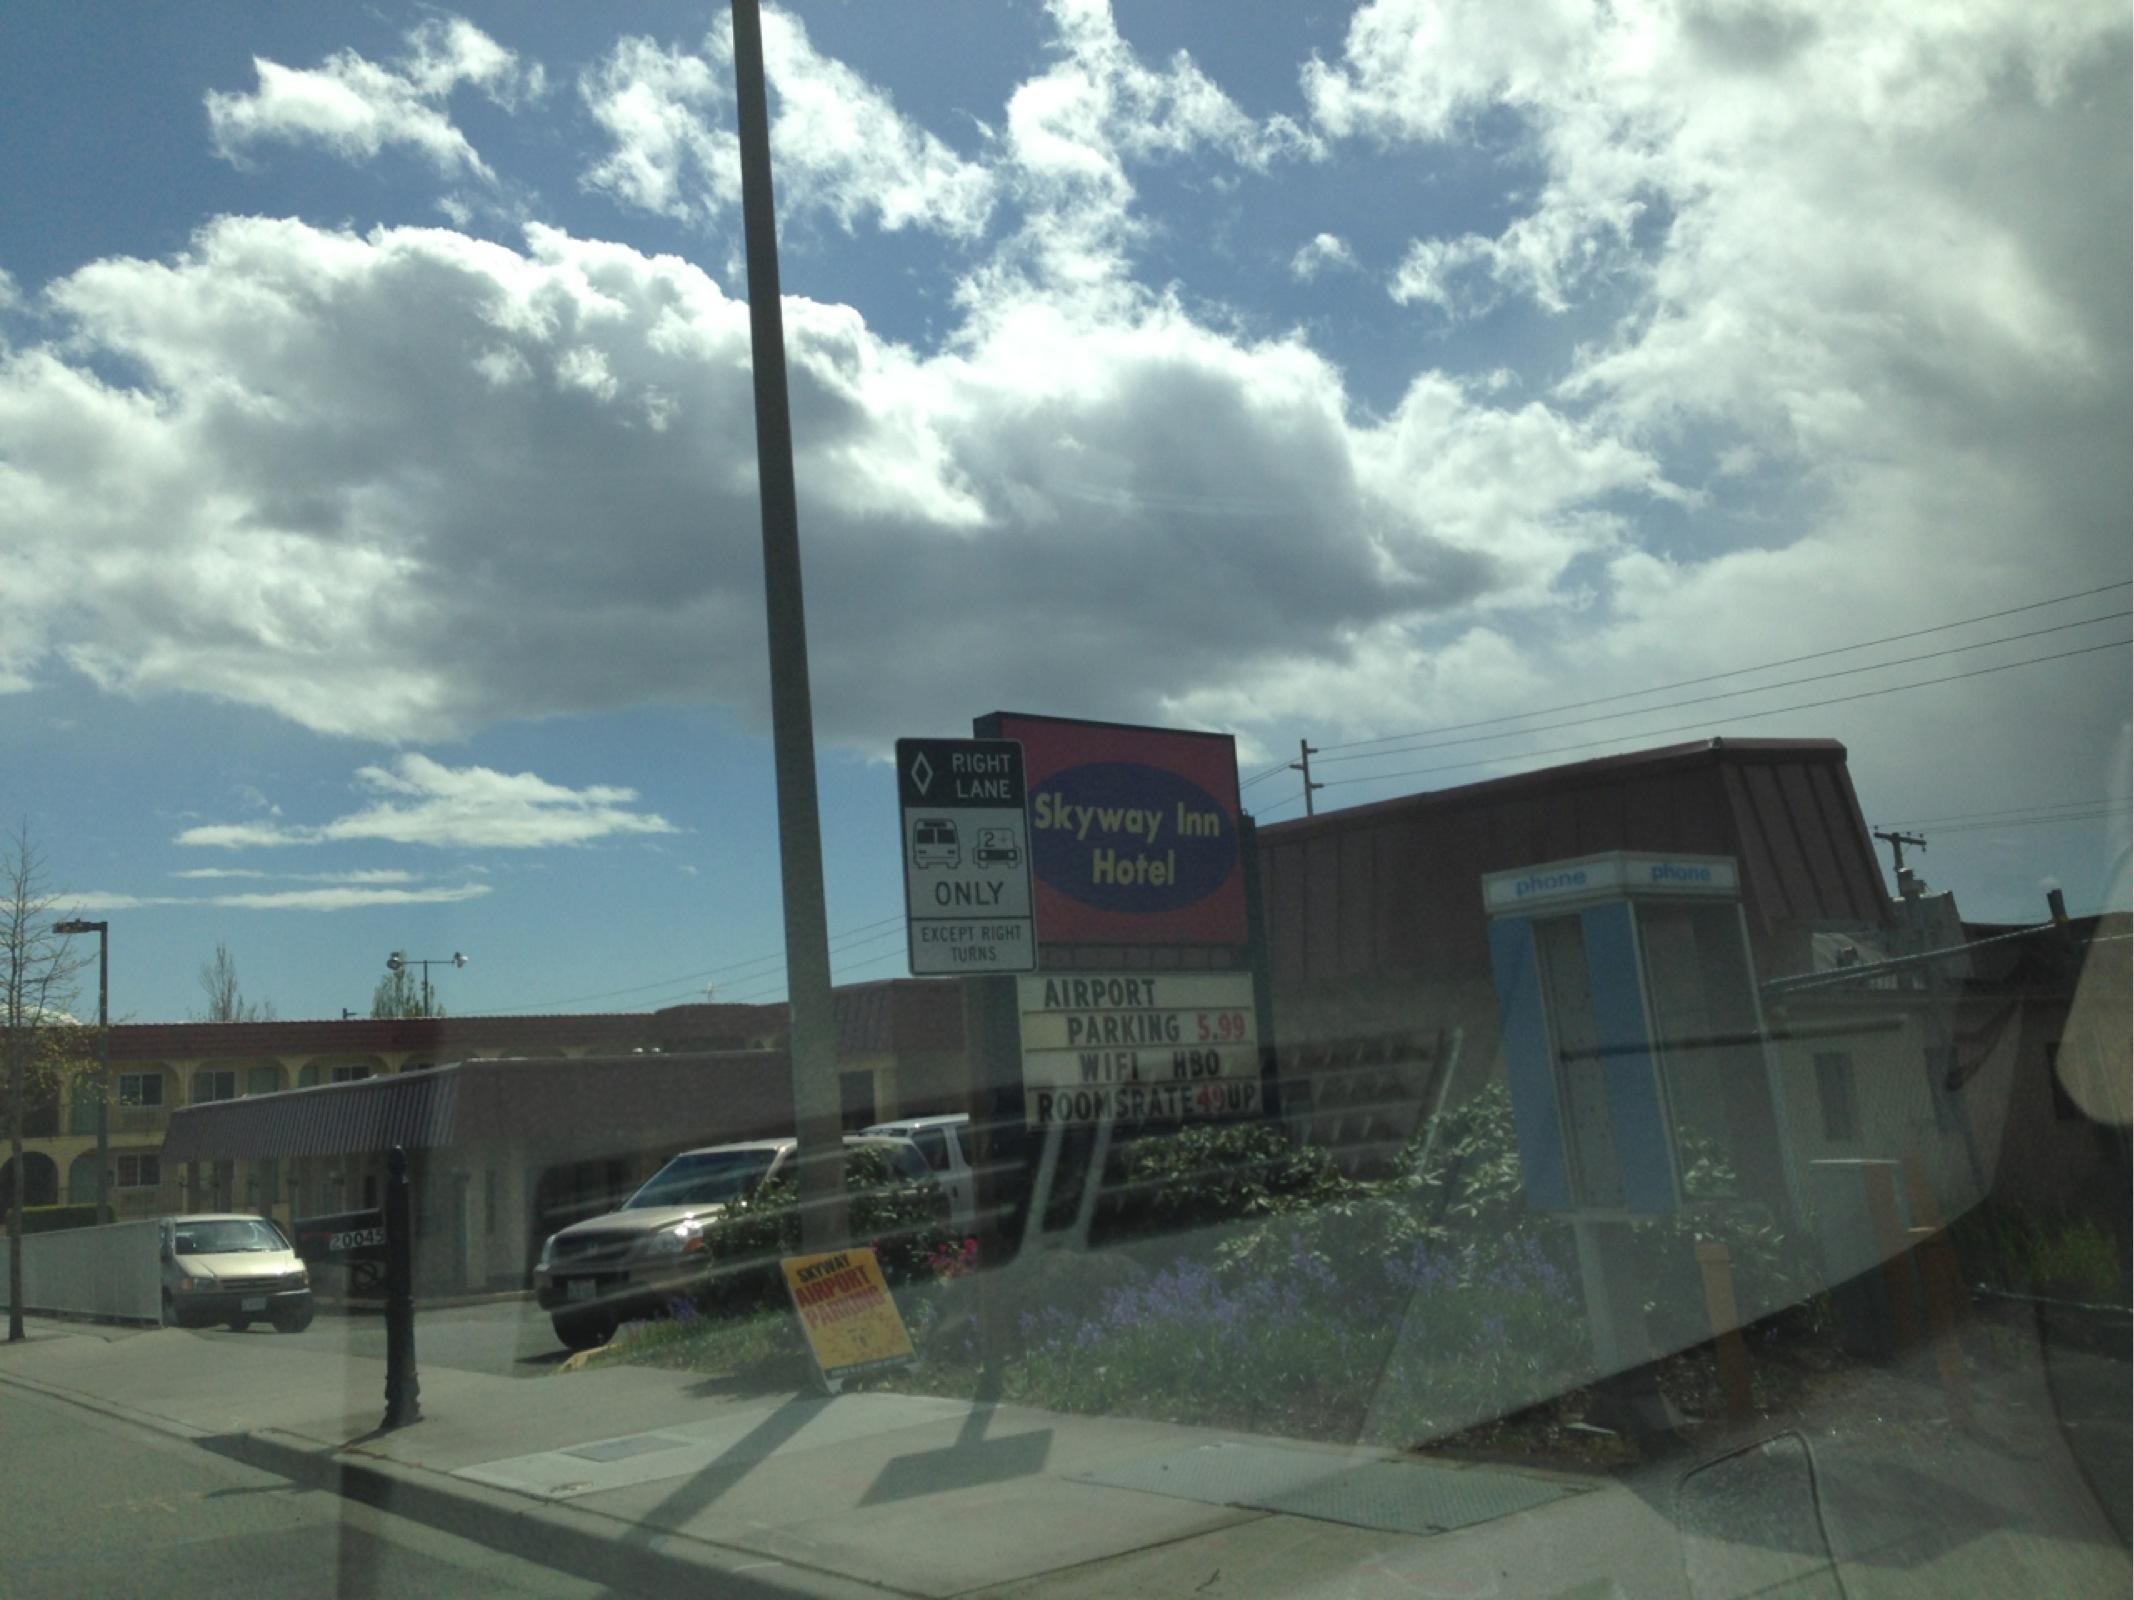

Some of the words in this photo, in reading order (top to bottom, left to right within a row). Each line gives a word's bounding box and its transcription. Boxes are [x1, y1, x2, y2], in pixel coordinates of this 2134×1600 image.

[952, 753, 1012, 774] RIGHT
[956, 779, 1012, 799] LANE
[1033, 792, 1164, 844] Skyway
[1177, 801, 1220, 837] Inn
[1092, 849, 1175, 886] Hotel
[1652, 863, 1712, 883] phone
[935, 881, 1004, 906] ONLY
[1516, 870, 1587, 896] phone
[922, 926, 975, 943] EXCEPT
[982, 924, 1021, 941] RIGHT
[952, 946, 997, 962] TURNS
[1044, 978, 1156, 1008] AIRPORT
[1067, 1013, 1181, 1045] PARKING
[1197, 1013, 1246, 1042] 5.99
[1079, 1051, 1139, 1082] WIFI
[1172, 1049, 1221, 1079] HBO
[796, 1253, 850, 1283] SKYWAY
[795, 1264, 872, 1308] AIRPORT
